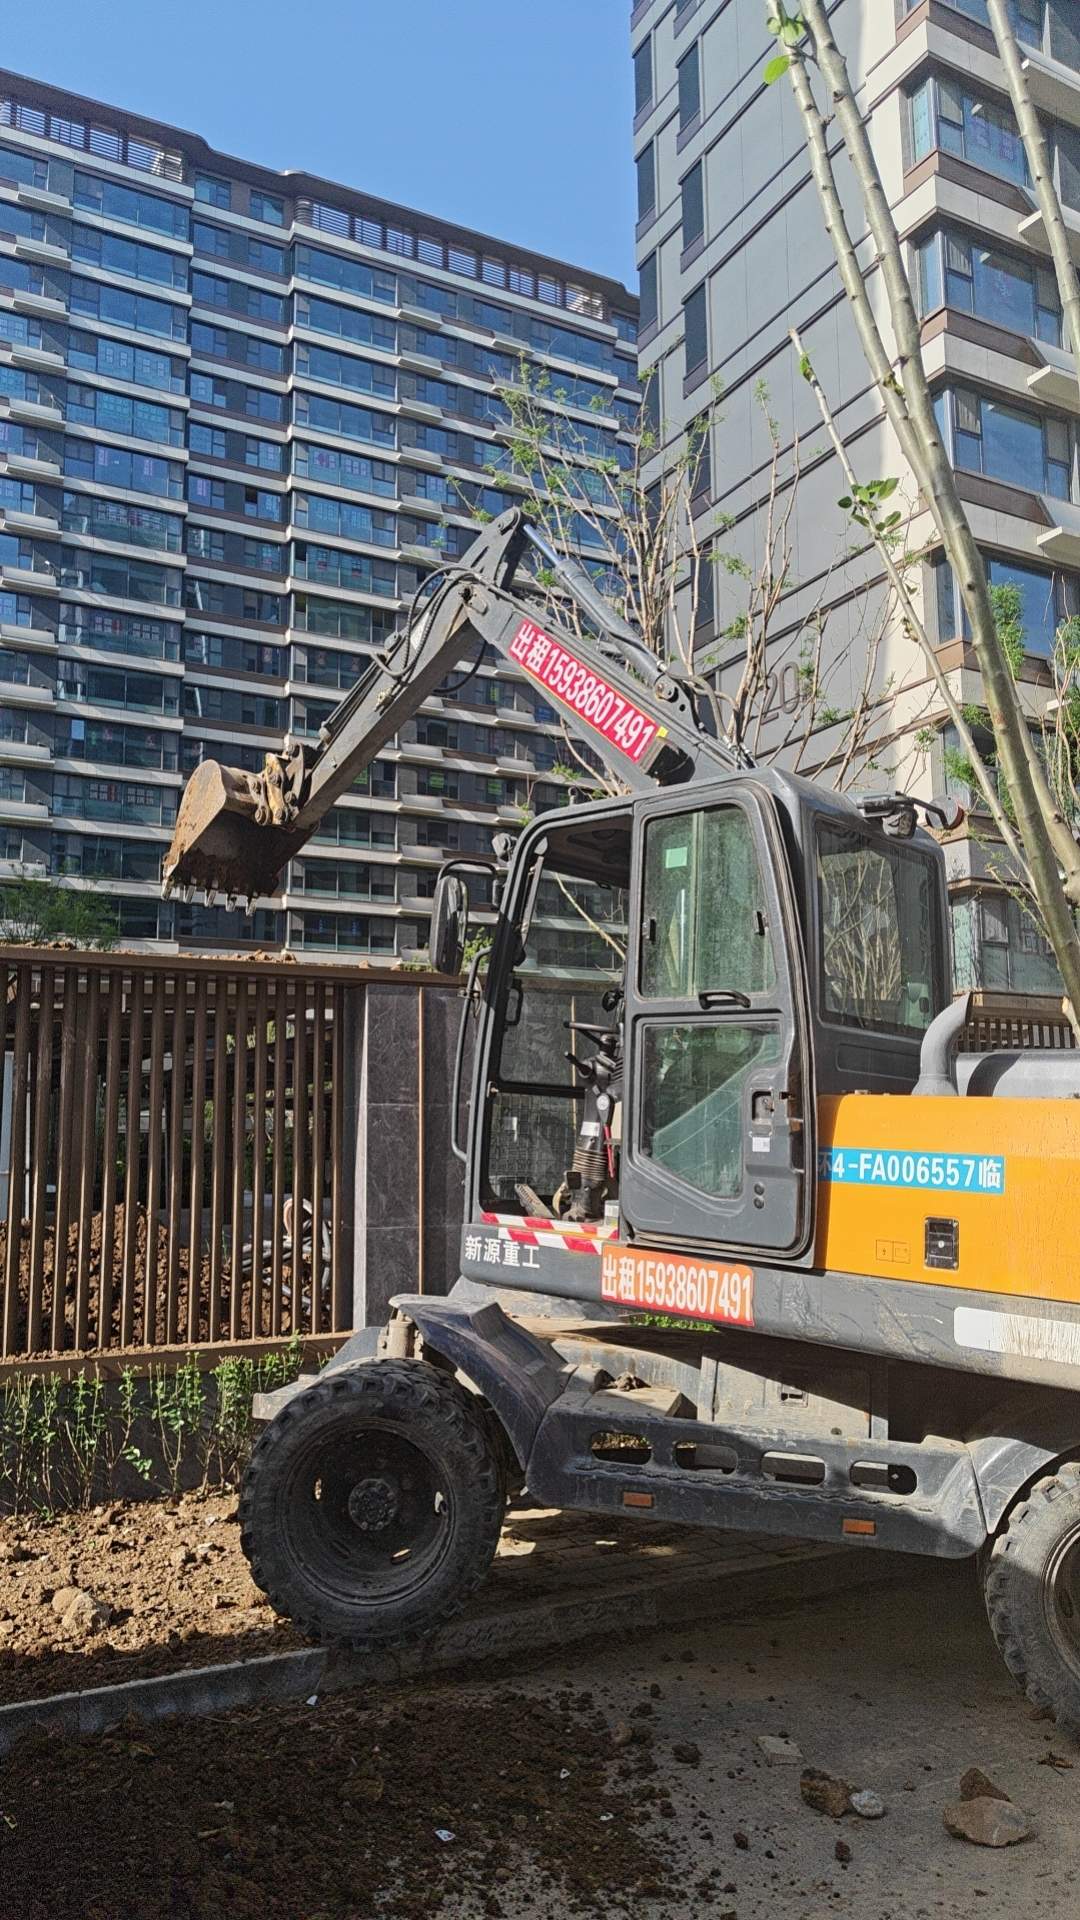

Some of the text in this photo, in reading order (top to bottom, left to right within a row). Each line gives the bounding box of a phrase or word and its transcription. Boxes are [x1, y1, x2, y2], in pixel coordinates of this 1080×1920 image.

[509, 622, 656, 759] 出租15938607491
[464, 1235, 541, 1269] 新源重工
[602, 1254, 753, 1321] 出租15938607491
